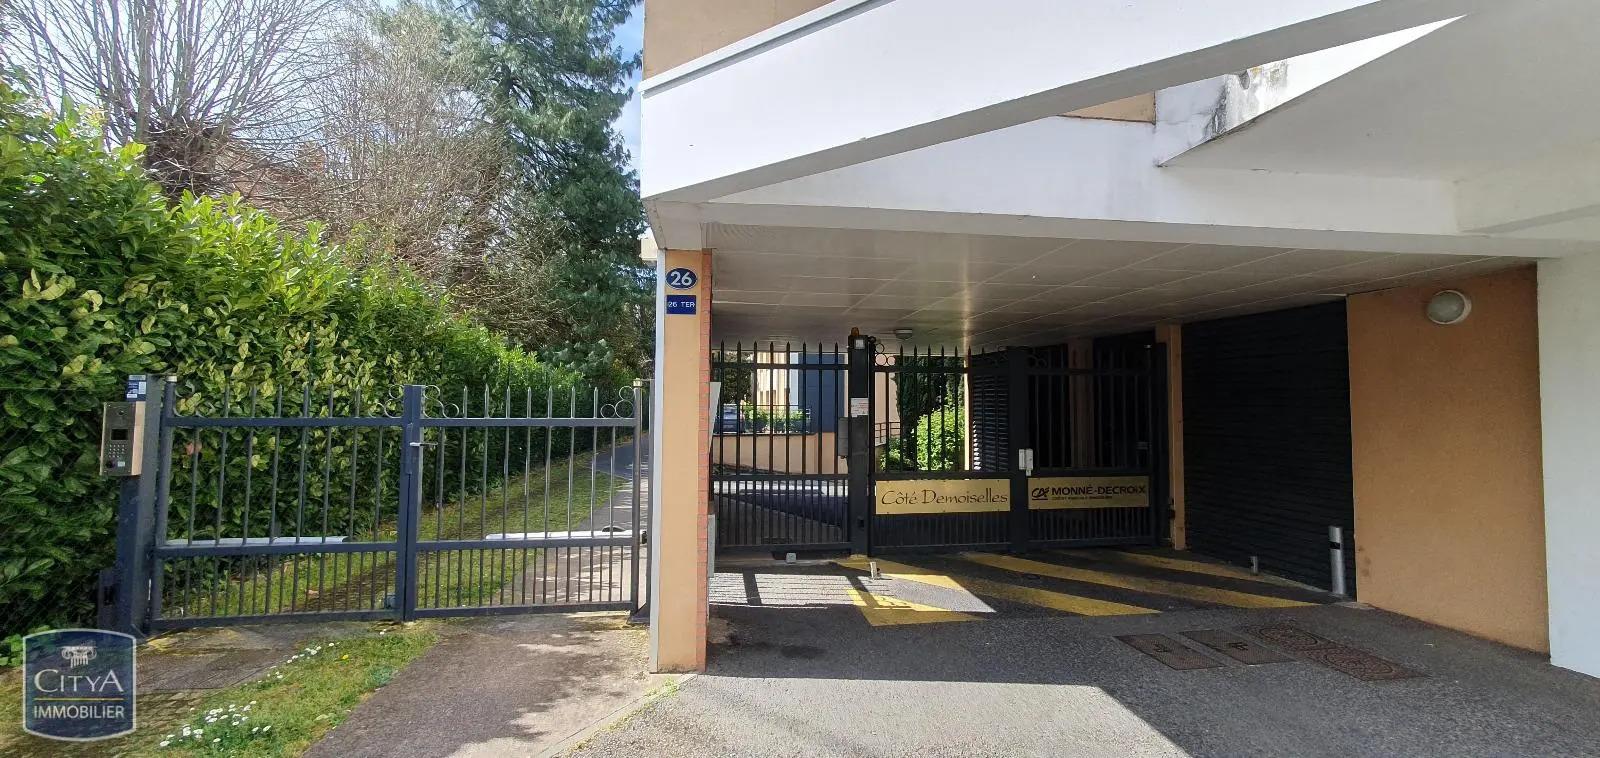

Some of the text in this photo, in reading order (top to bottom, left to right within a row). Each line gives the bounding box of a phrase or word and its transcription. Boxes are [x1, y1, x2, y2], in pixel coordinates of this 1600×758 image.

[670, 270, 692, 286] 26
[881, 488, 1008, 505] Côté Demoiselles
